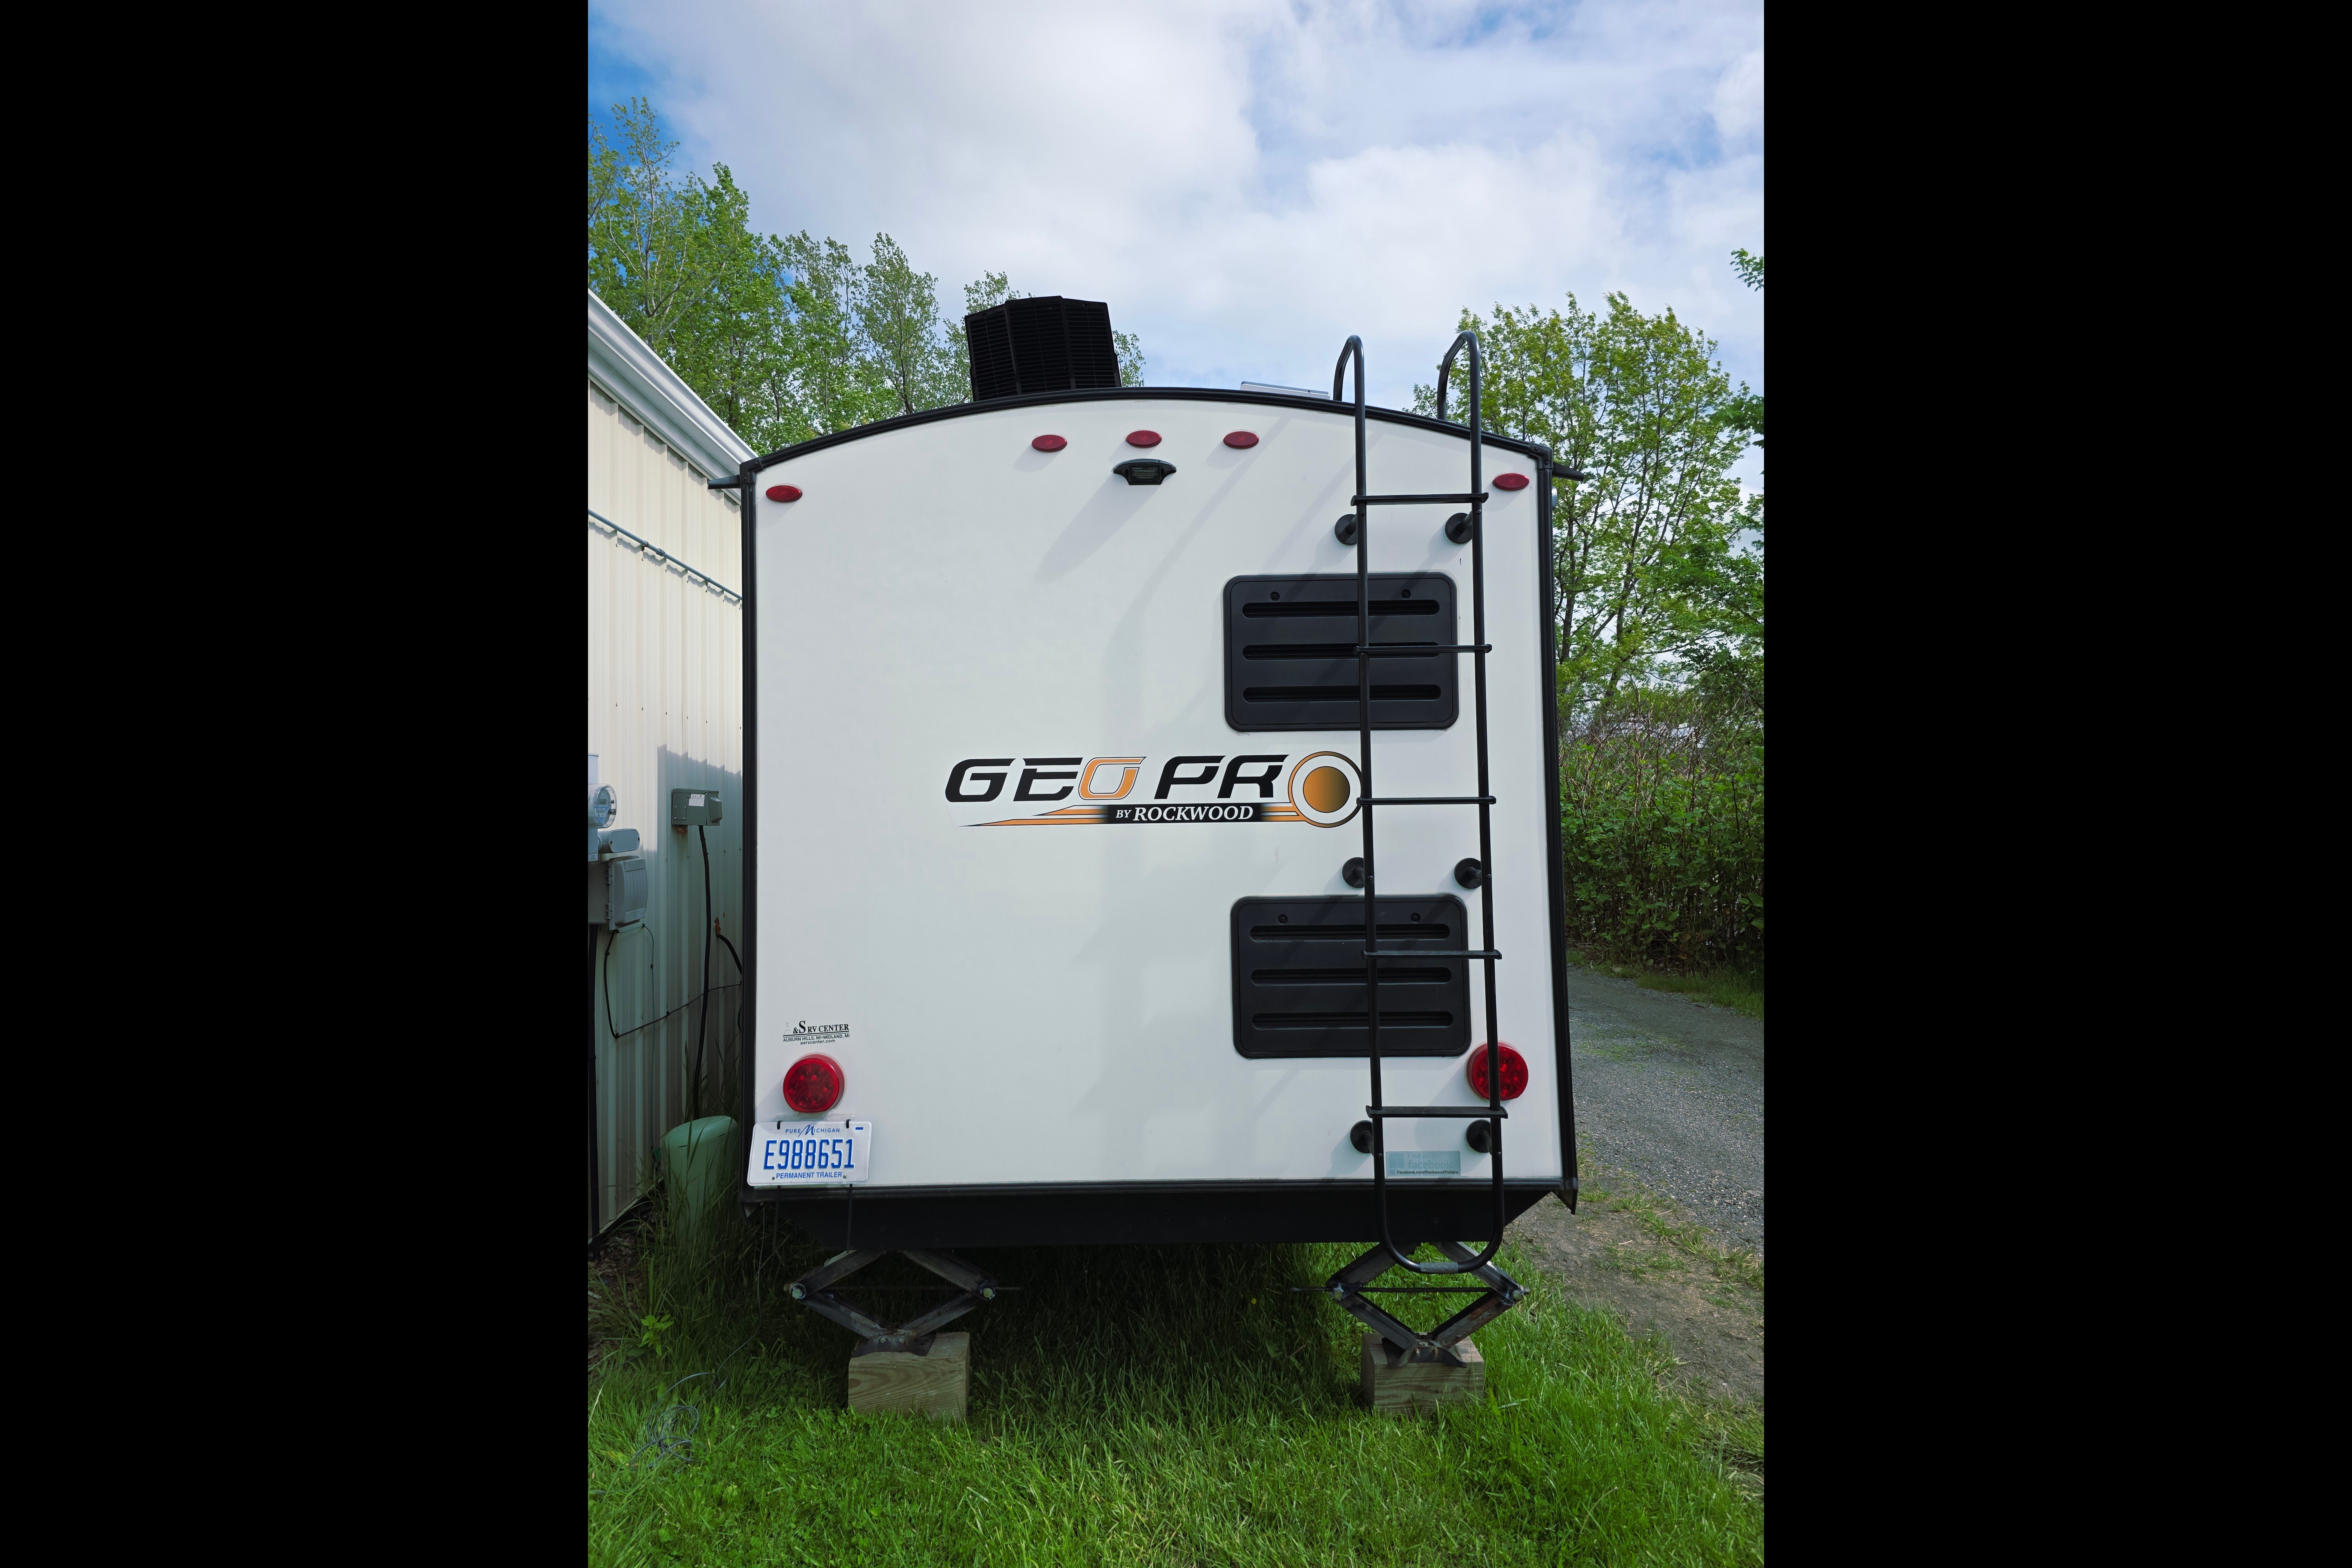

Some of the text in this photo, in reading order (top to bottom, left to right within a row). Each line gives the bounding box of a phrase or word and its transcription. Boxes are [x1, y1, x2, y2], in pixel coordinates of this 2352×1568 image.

[945, 756, 1147, 802] GEO
[1116, 806, 1254, 821] BY ROCKWOOD
[818, 1024, 849, 1032] CENTER
[798, 1125, 840, 1138] MICHIGAN
[763, 1139, 855, 1170] E988651
[1408, 1160, 1452, 1169] facebook
